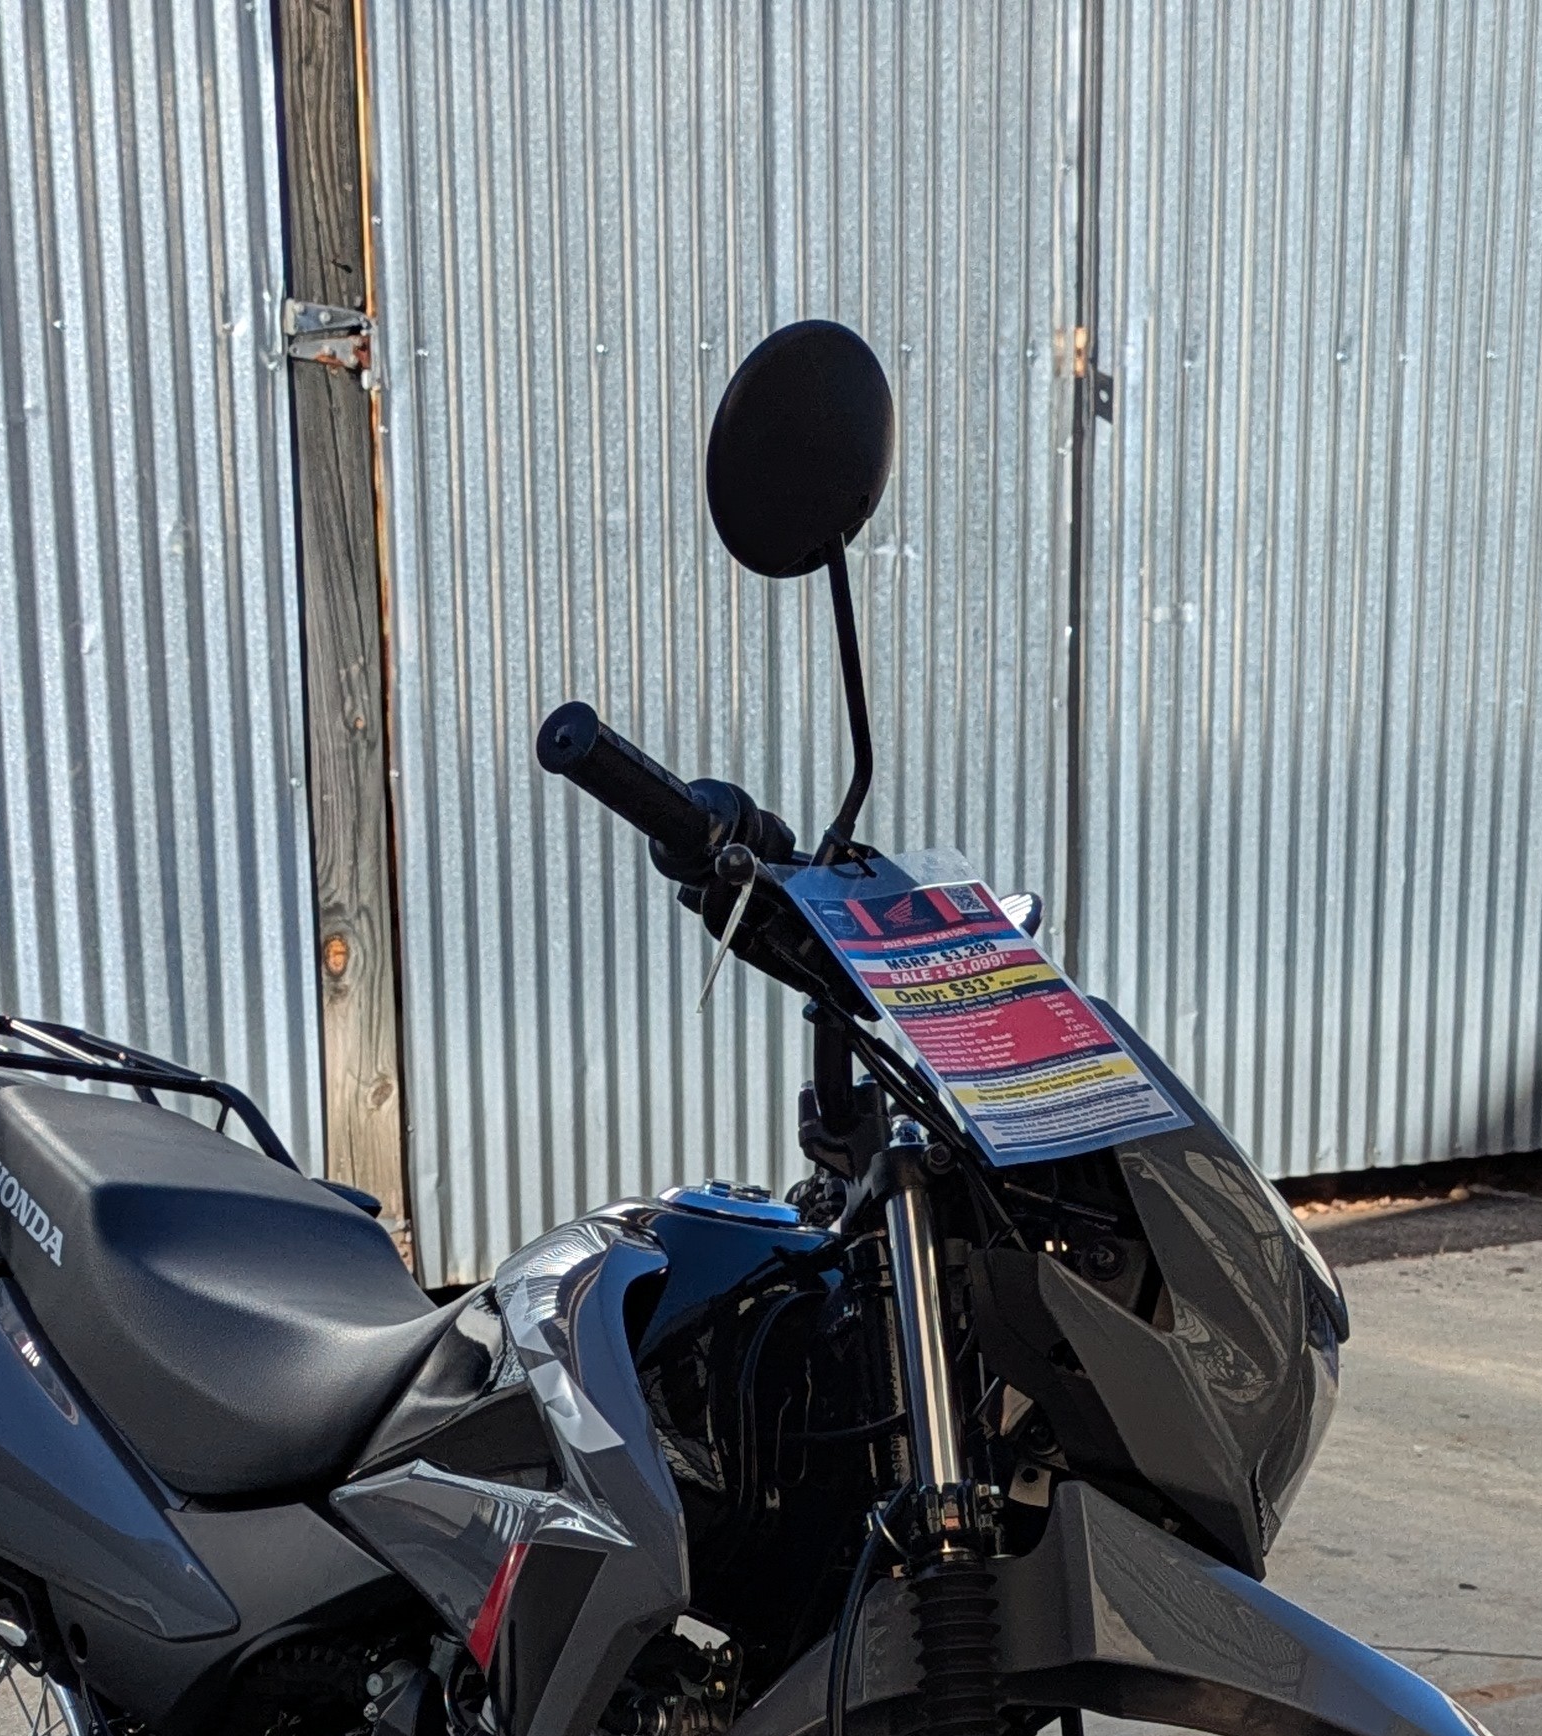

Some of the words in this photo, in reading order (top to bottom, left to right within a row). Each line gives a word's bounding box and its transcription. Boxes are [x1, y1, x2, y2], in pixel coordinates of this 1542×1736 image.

[884, 955, 939, 971] MSRP:
[890, 969, 933, 985] SALE
[894, 987, 949, 1004] Only:
